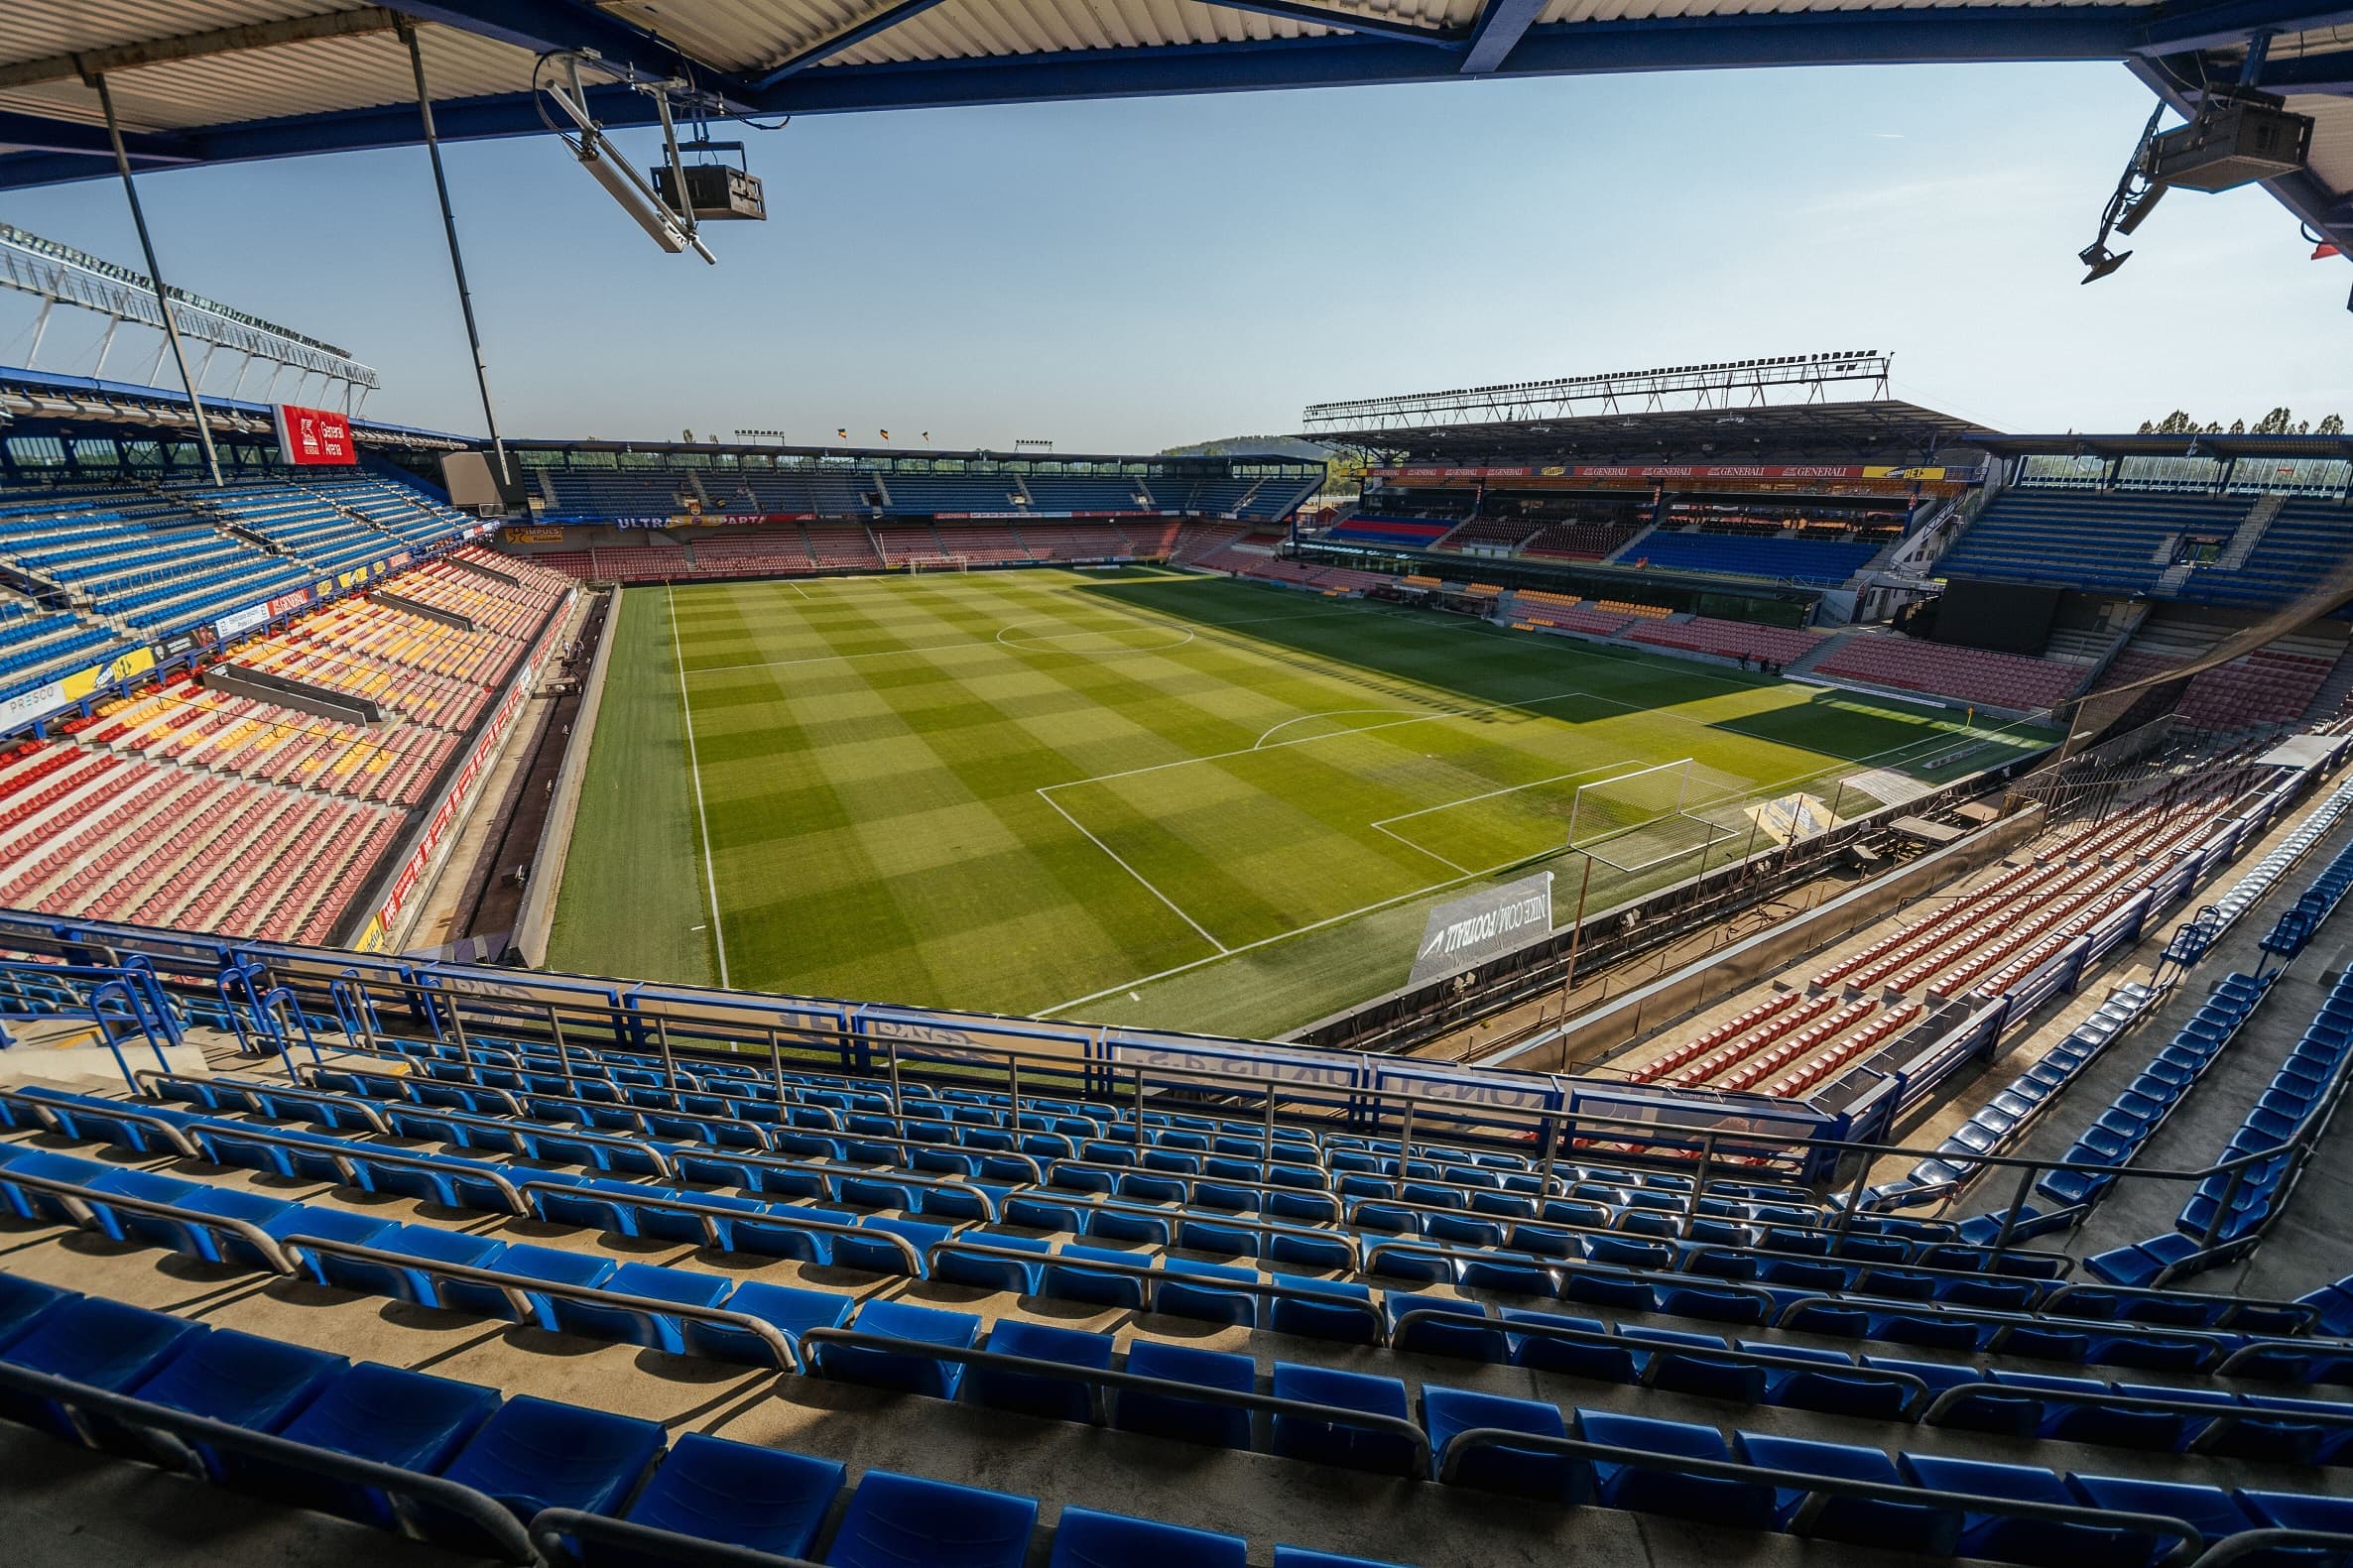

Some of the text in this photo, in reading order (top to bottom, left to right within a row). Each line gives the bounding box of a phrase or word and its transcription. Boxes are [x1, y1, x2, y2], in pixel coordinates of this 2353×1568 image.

[324, 439, 342, 455] Arena
[1797, 467, 1847, 476] GENERALI
[10, 686, 55, 712] PRESCO
